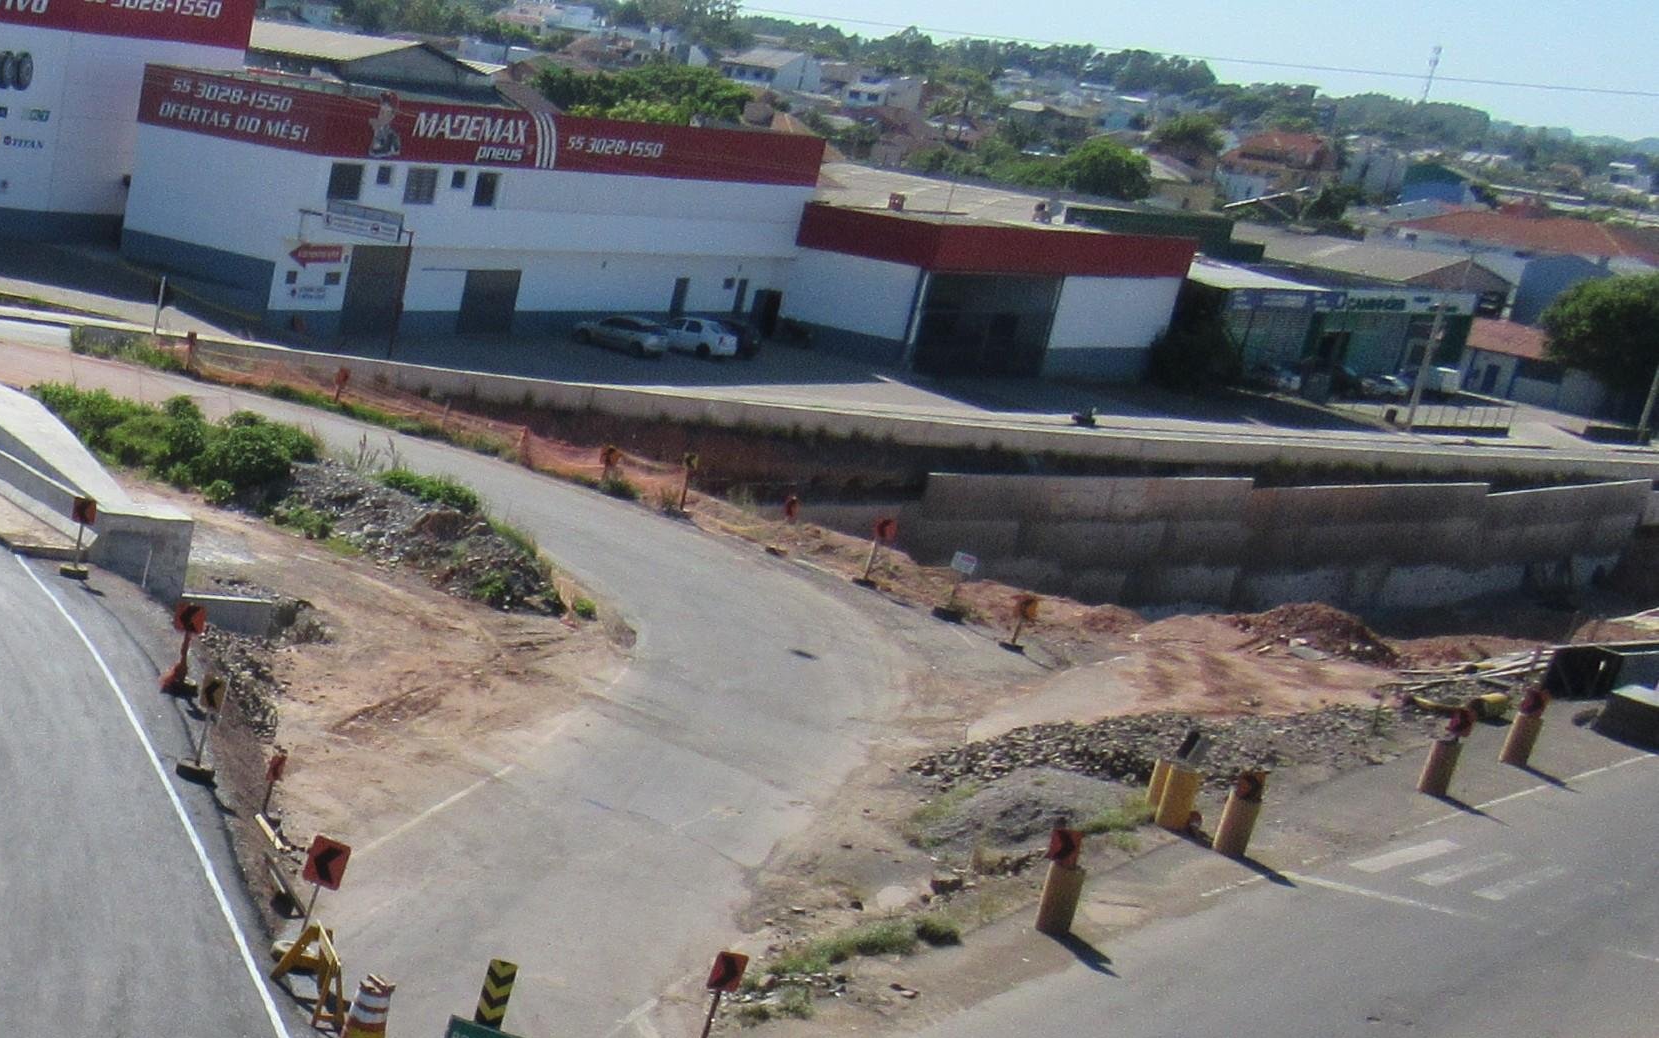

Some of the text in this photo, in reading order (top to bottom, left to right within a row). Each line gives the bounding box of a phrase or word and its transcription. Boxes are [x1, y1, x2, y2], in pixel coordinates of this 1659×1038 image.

[172, 79, 293, 113] 55 3028-1550
[158, 101, 232, 129] OFERTAS
[264, 119, 310, 142] MÊS!
[412, 111, 529, 145] MADEMAX
[12, 138, 44, 149] TITAN
[475, 145, 524, 163] pneus
[566, 136, 664, 158] 55 3028-1550
